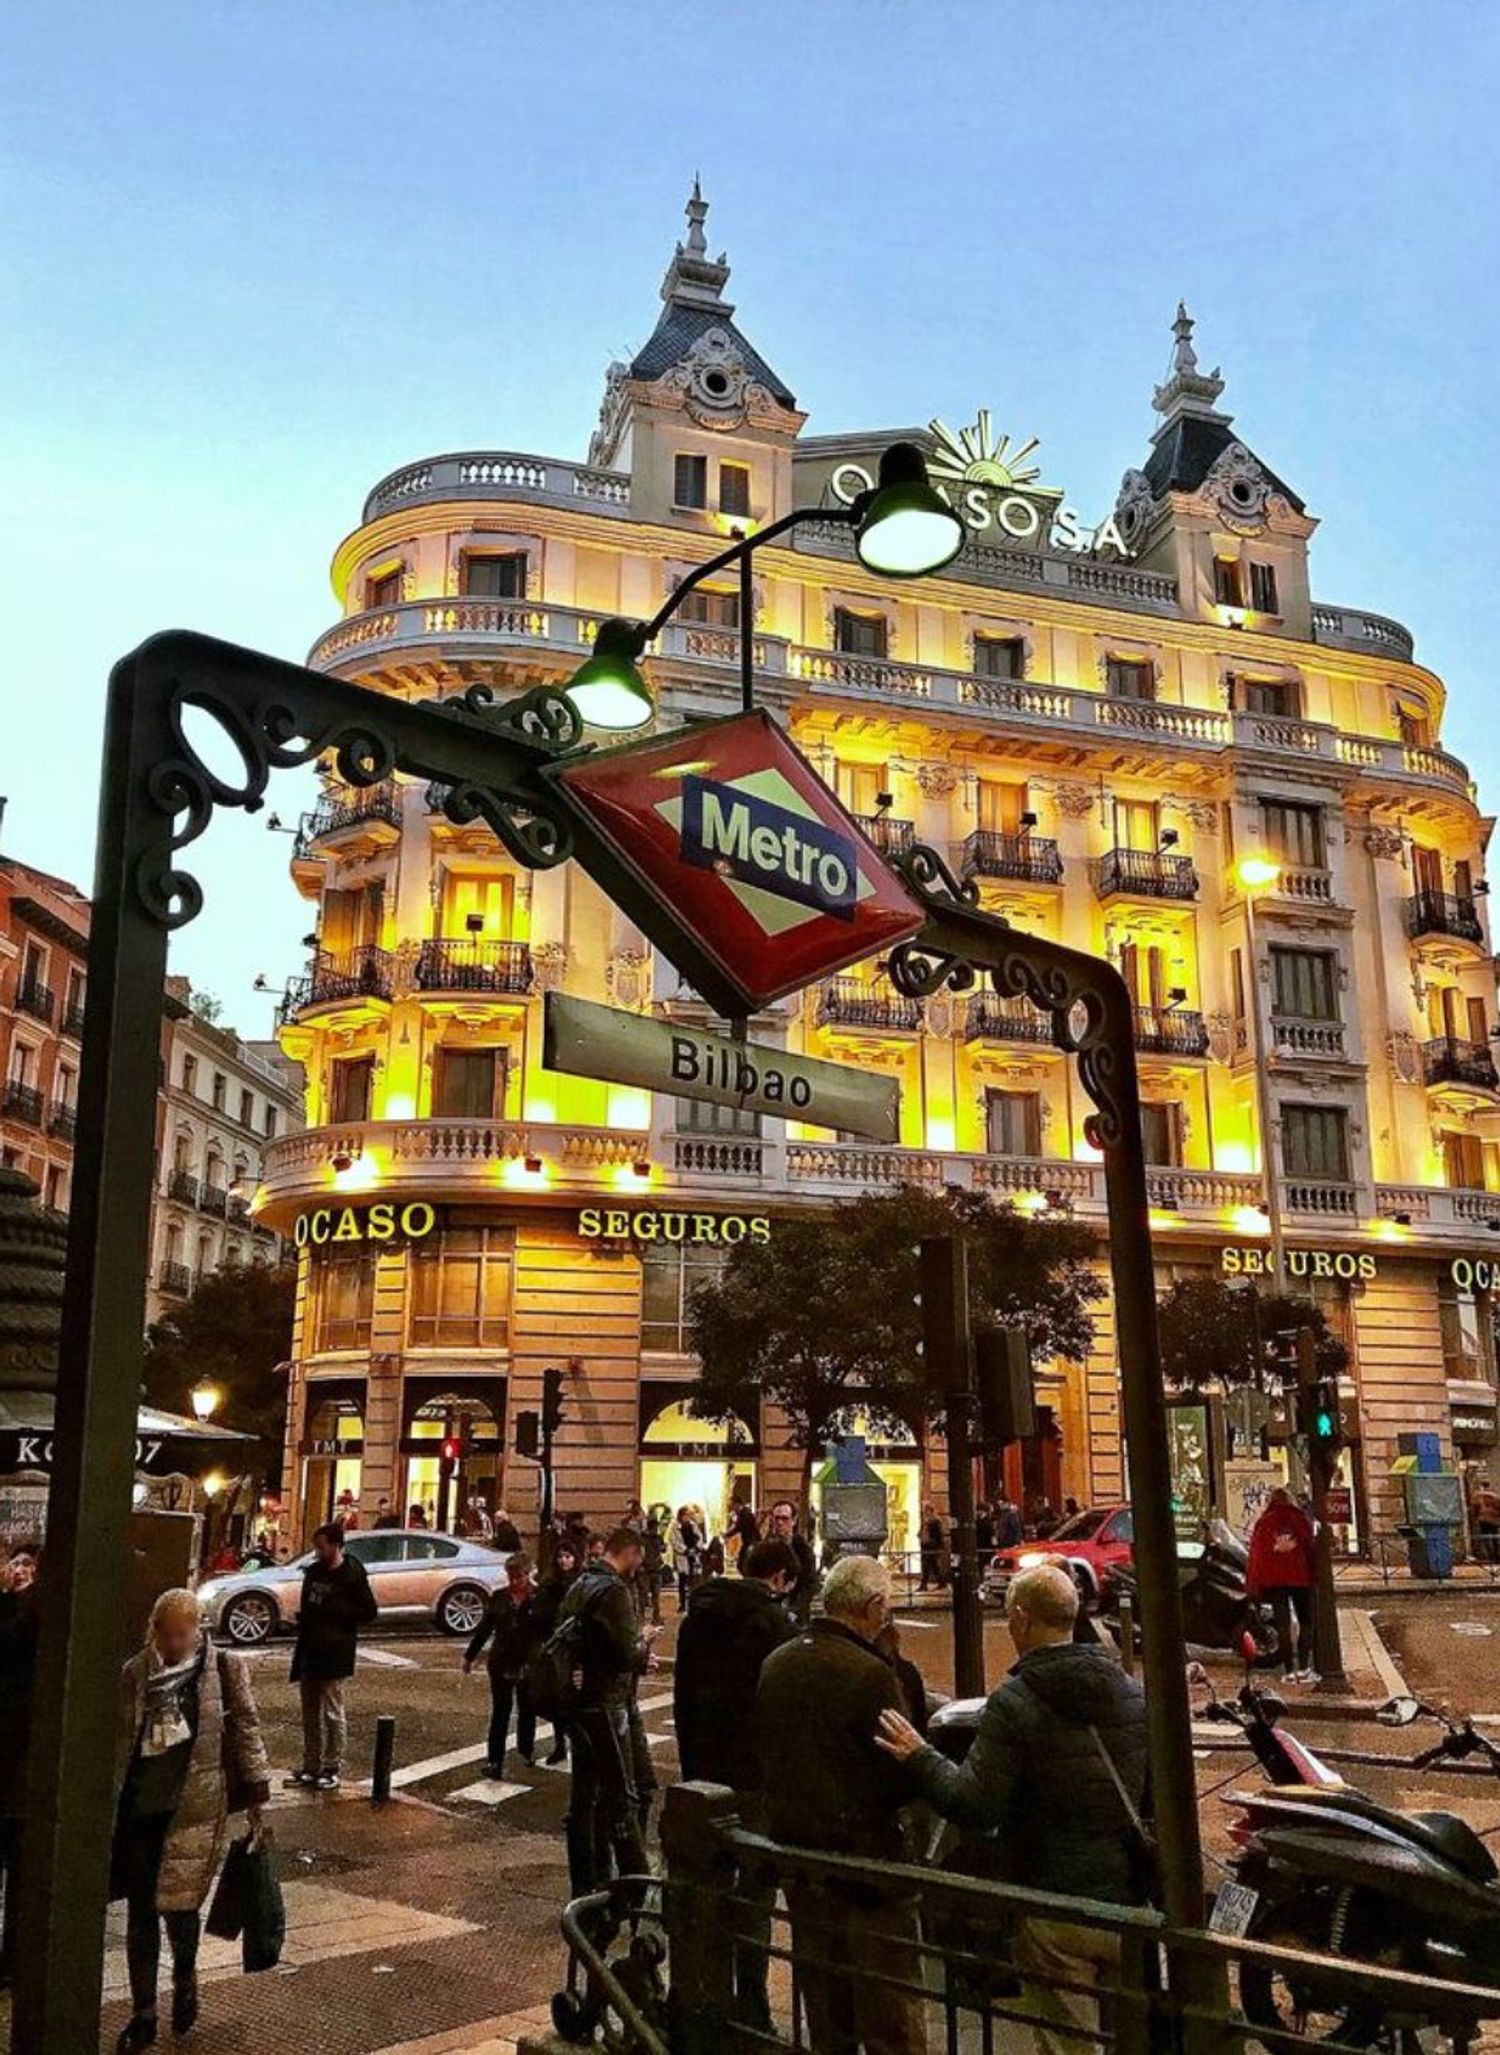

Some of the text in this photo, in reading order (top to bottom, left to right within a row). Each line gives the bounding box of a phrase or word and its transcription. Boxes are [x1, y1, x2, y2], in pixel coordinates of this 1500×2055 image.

[831, 463, 1038, 537] OSO
[701, 792, 847, 896] Metro
[671, 1037, 812, 1108] Bilbao
[295, 1203, 436, 1248] OCASO
[578, 1208, 772, 1244] SEGUROS
